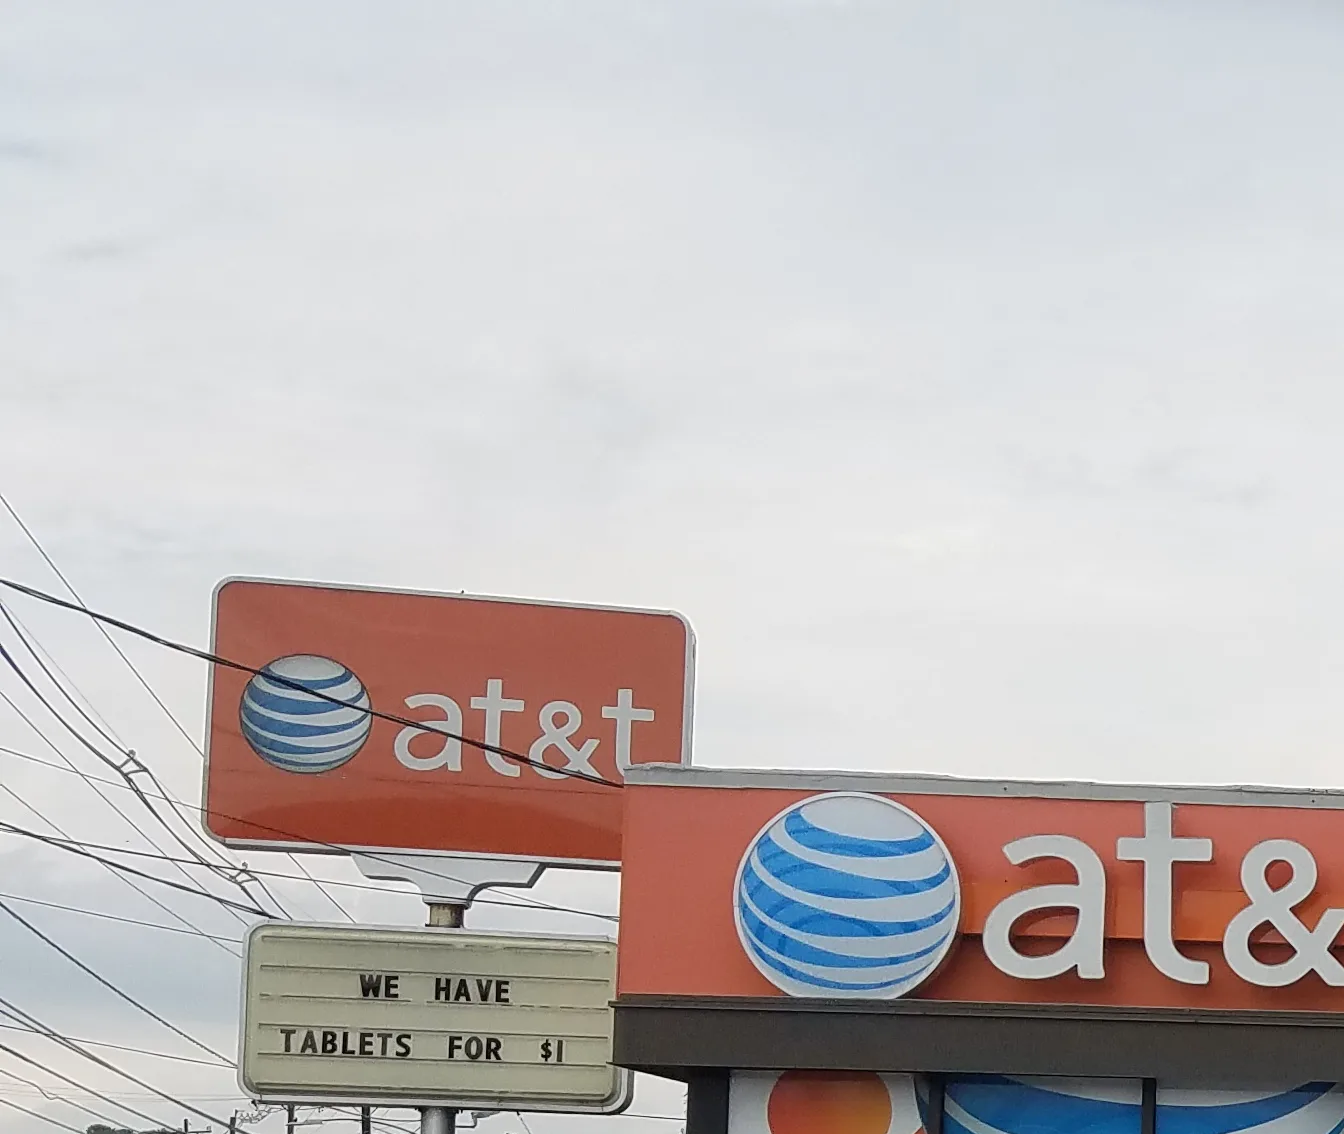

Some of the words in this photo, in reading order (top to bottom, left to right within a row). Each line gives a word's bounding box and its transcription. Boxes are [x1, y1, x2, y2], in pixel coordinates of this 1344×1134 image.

[359, 974, 399, 999] WE
[434, 977, 510, 1003] HAVE
[280, 1029, 412, 1058] TABLETS
[448, 1035, 503, 1061] FOR
[540, 1038, 564, 1063] $1
